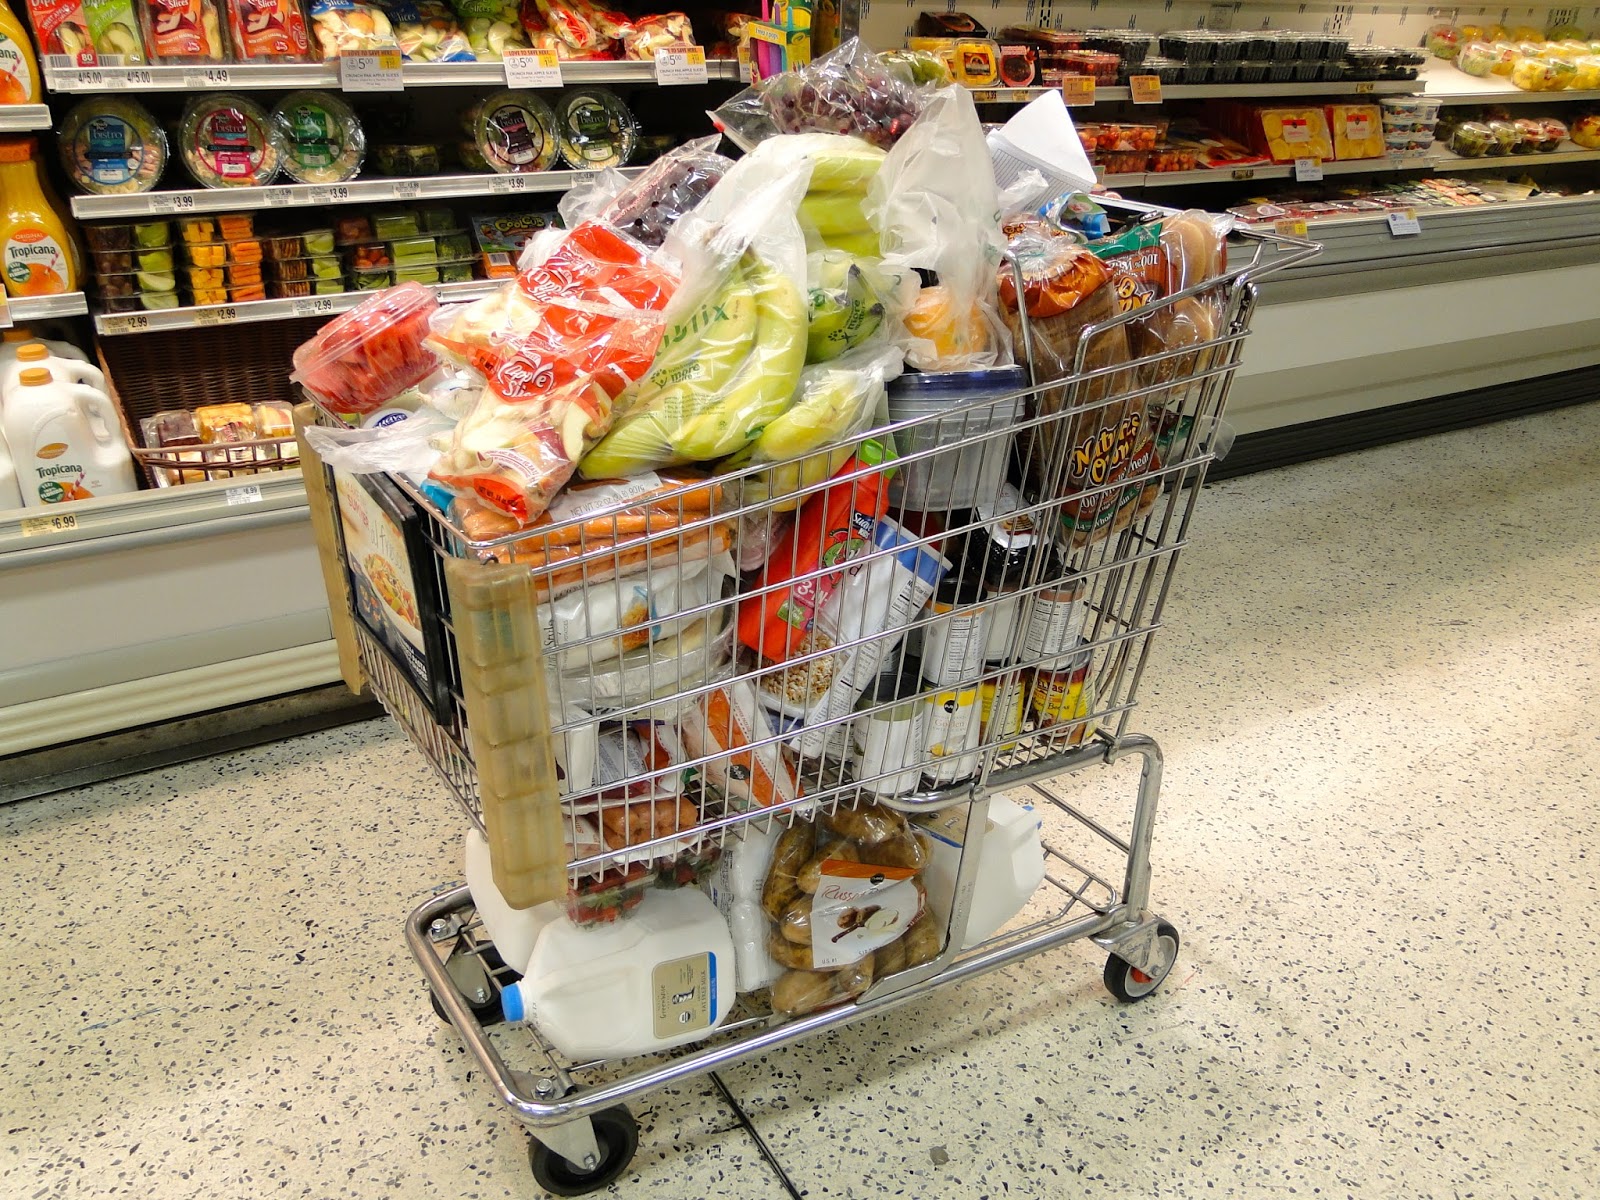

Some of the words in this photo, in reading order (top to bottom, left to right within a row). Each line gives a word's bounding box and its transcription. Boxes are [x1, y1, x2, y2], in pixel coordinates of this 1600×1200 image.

[169, 0, 189, 8] Slices
[259, 0, 281, 8] Slices
[205, 70, 228, 82] $4.49
[92, 128, 124, 140] bistro
[214, 123, 247, 135] bistro
[508, 177, 525, 189] $3.99
[329, 187, 348, 199] $3.99
[173, 195, 194, 208] $3.99
[8, 244, 56, 259] Tropicana
[315, 299, 332, 311] $2.99
[217, 308, 236, 320] $2.99
[128, 316, 148, 328] $2.99
[36, 464, 83, 479] Tropicana
[570, 506, 582, 517] NET
[584, 502, 594, 512] WT
[51, 515, 76, 529] $6.99
